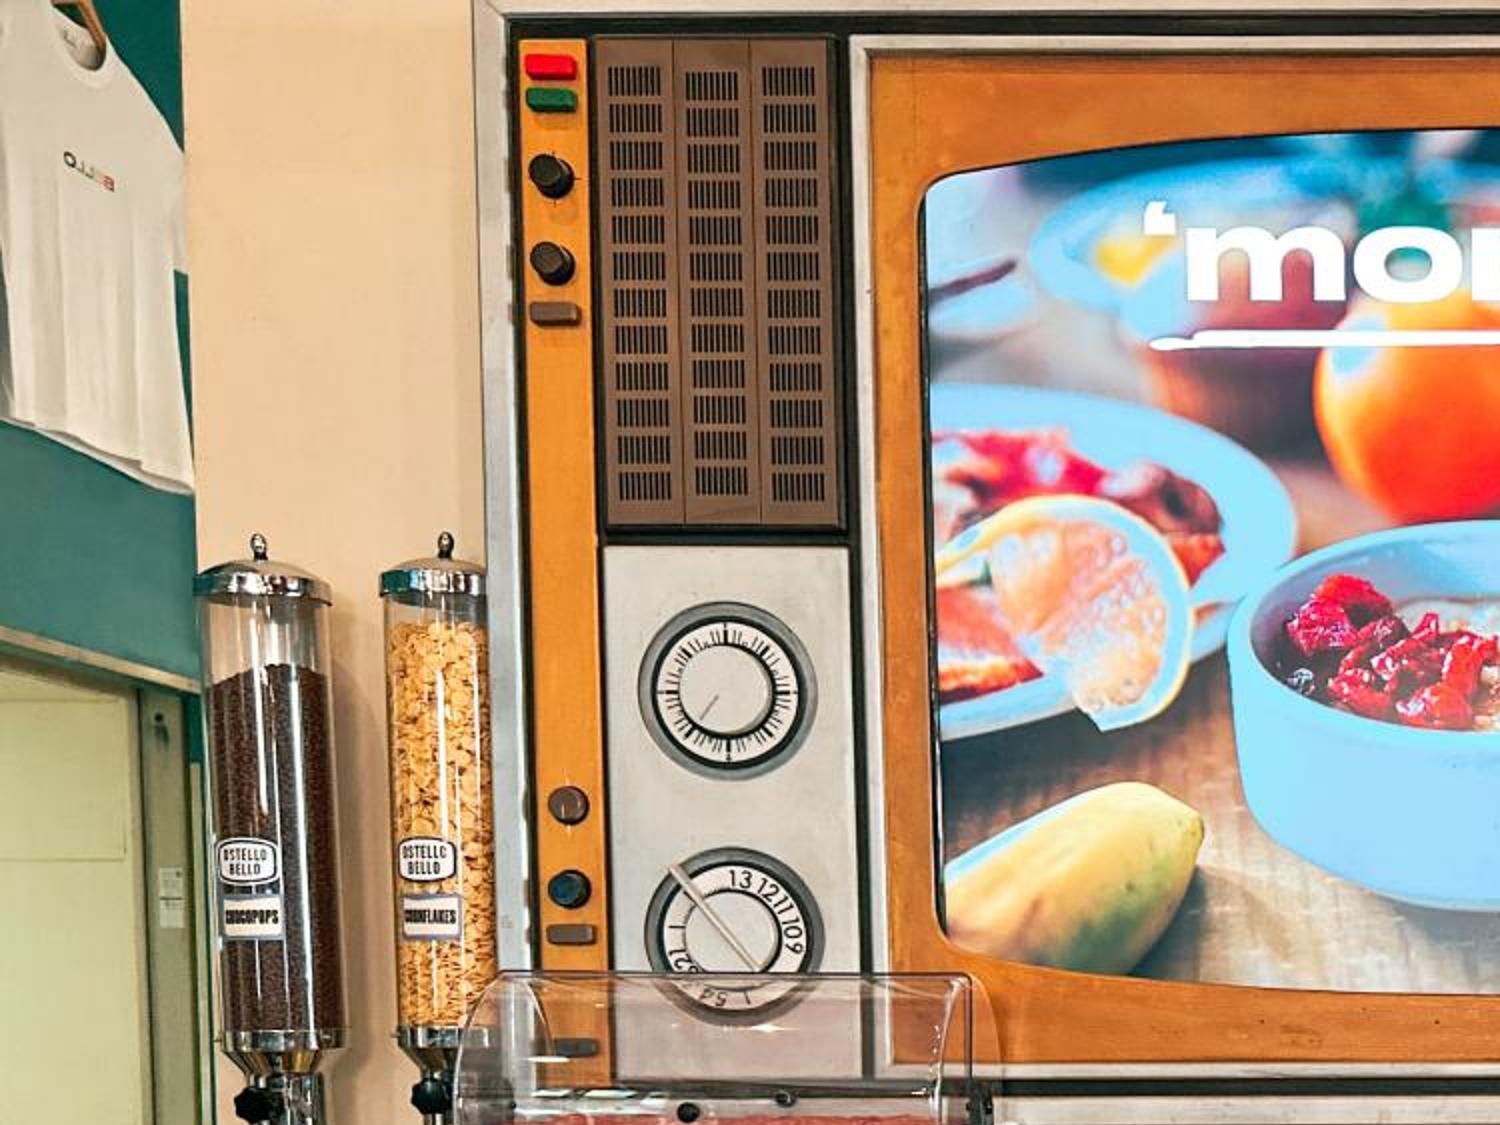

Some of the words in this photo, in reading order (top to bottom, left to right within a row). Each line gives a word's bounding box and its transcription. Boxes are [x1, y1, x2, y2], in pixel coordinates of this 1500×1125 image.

[229, 863, 261, 875] BELLO
[408, 861, 441, 874] BELLO
[728, 869, 753, 889] 13
[755, 878, 781, 903] 12
[781, 917, 803, 938] 10
